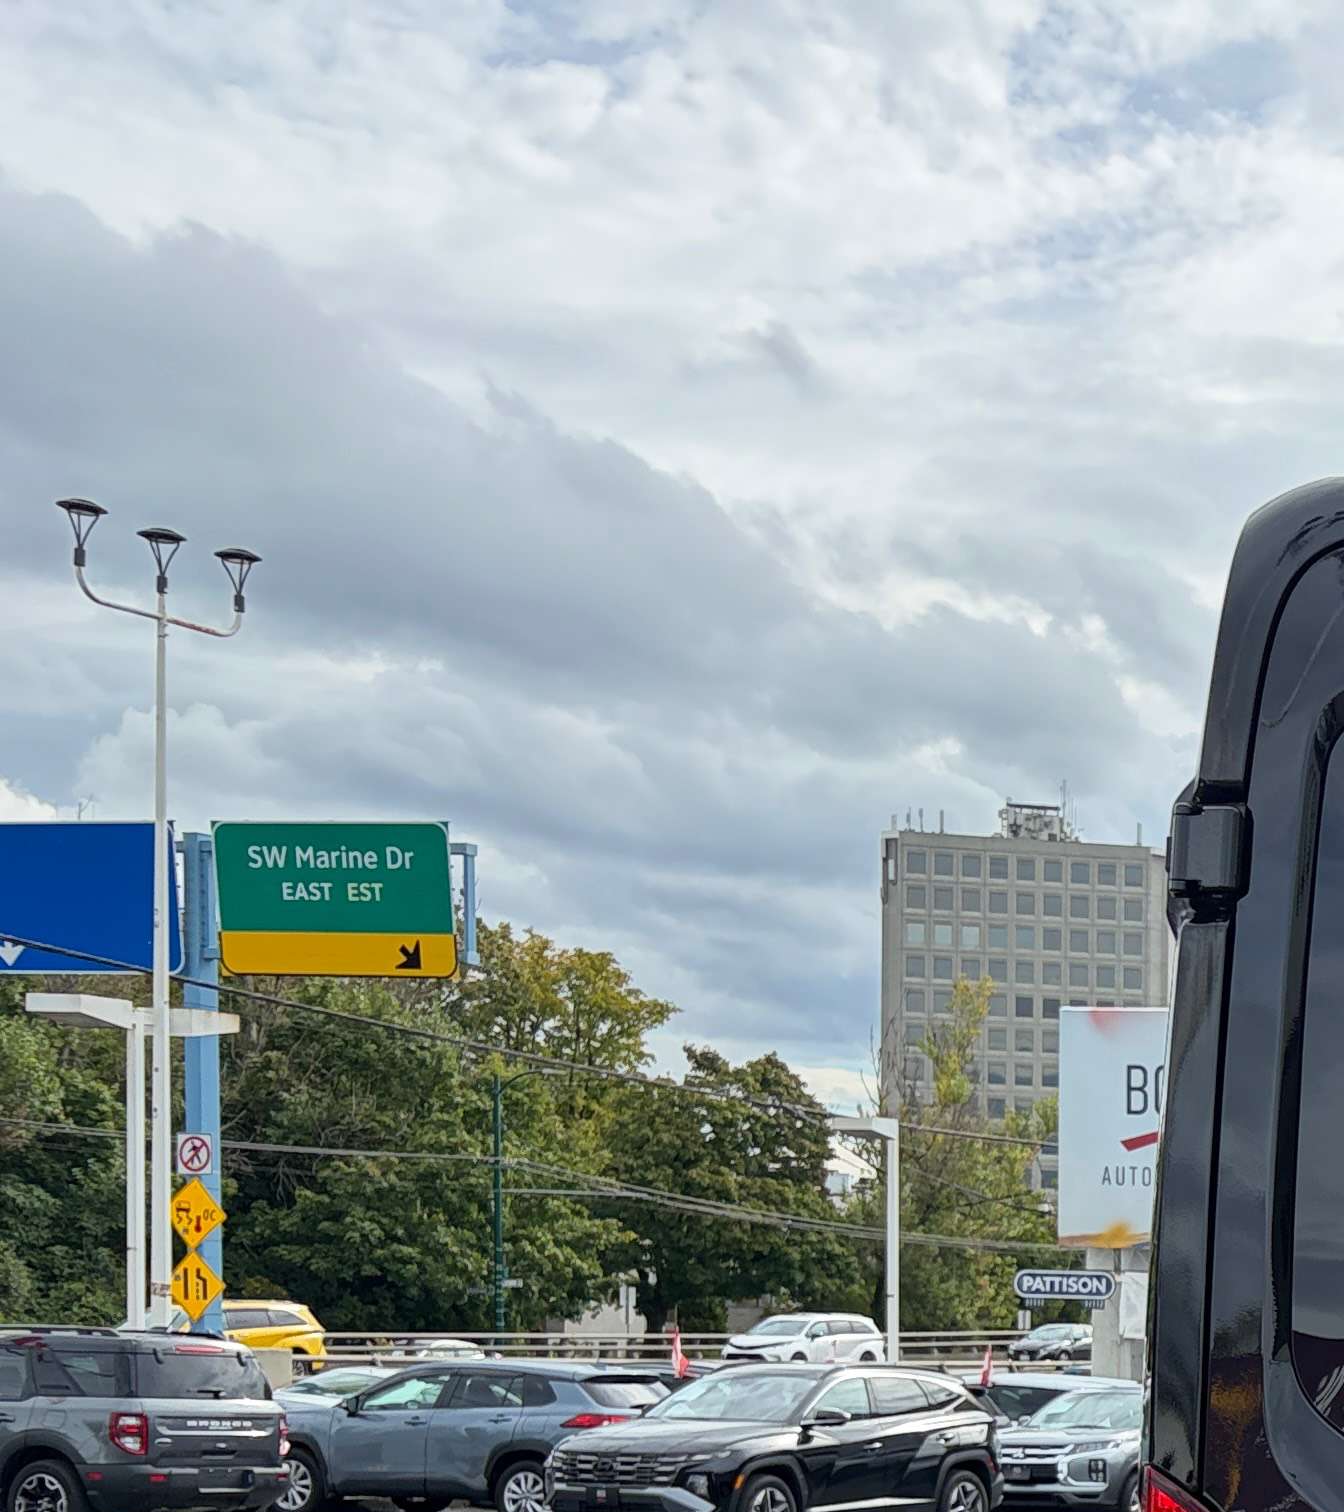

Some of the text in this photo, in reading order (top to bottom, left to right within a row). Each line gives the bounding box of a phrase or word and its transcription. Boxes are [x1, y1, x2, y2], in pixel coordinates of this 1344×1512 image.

[247, 845, 414, 870] SW Marine Dr
[282, 882, 383, 902] EAST EST
[1101, 1165, 1152, 1187] AUTO
[1021, 1275, 1107, 1294] PATTISON
